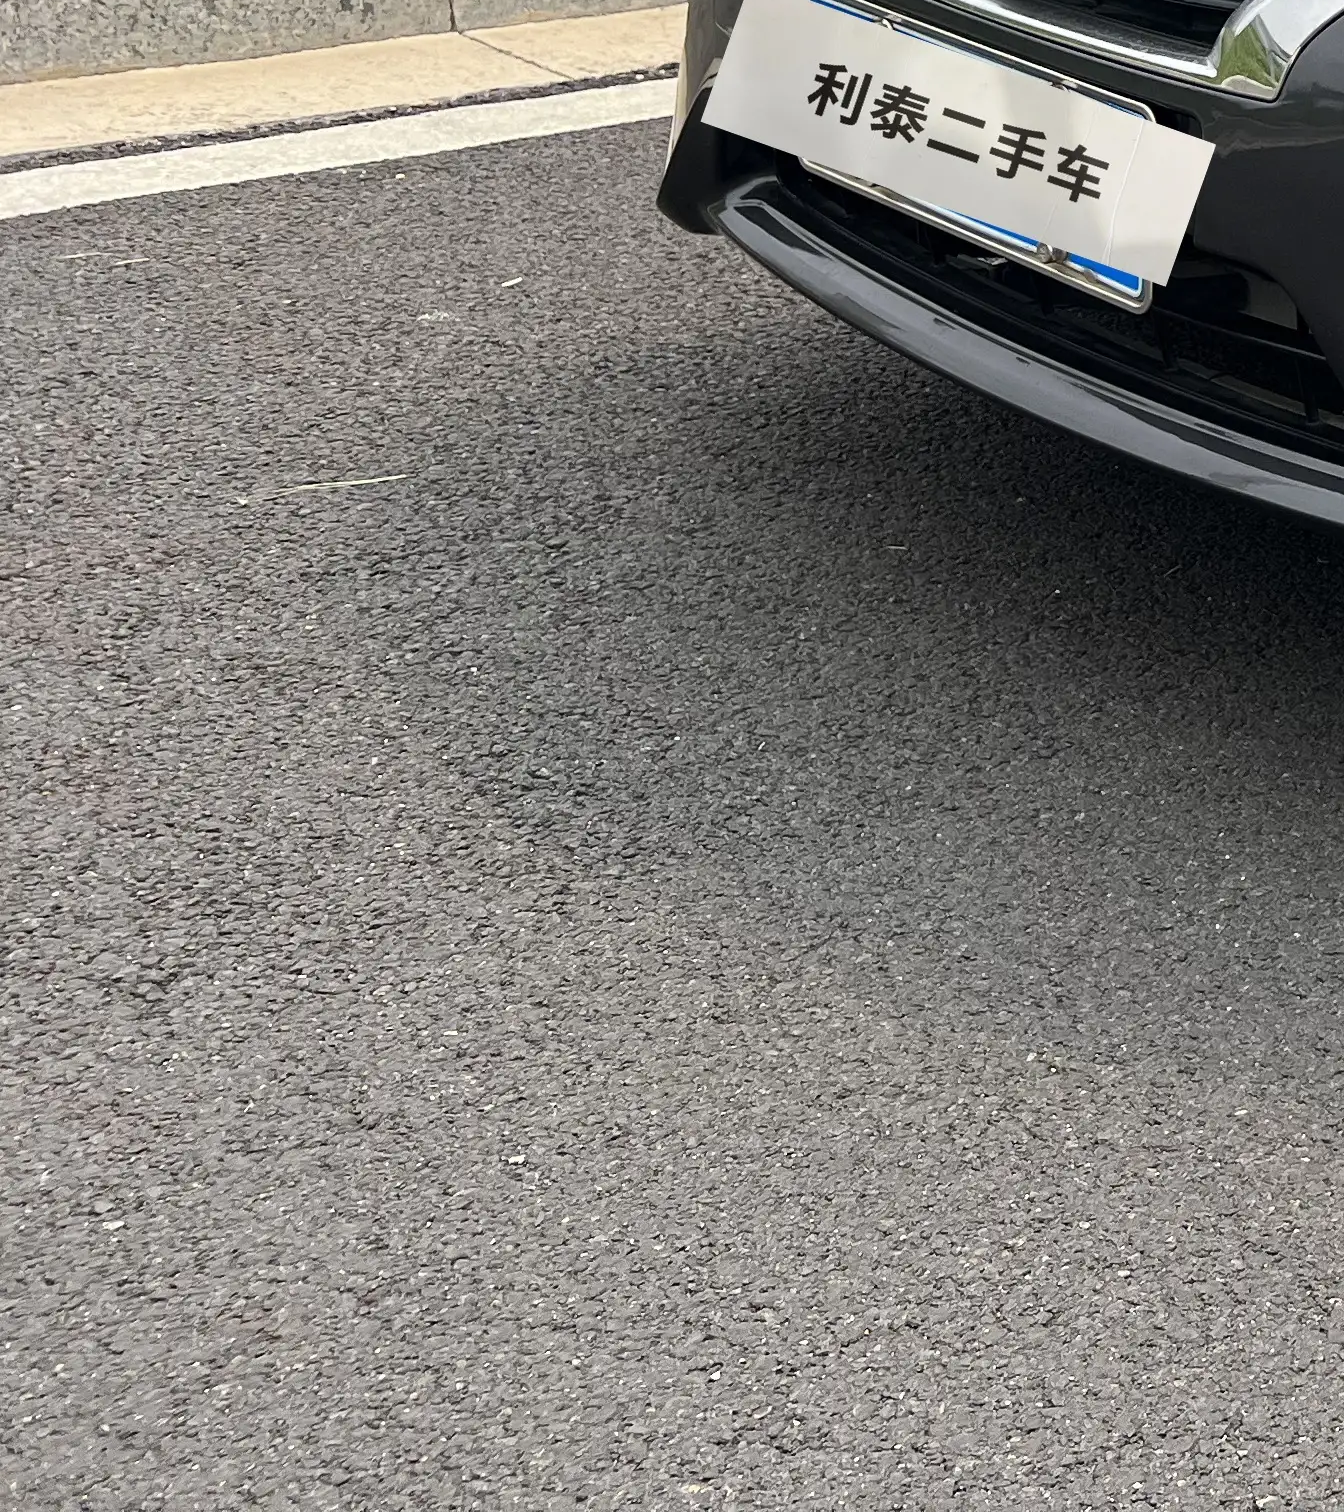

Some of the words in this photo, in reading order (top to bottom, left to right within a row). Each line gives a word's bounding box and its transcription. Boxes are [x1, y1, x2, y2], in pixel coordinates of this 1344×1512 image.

[806, 62, 1110, 204] 利泰二手车
